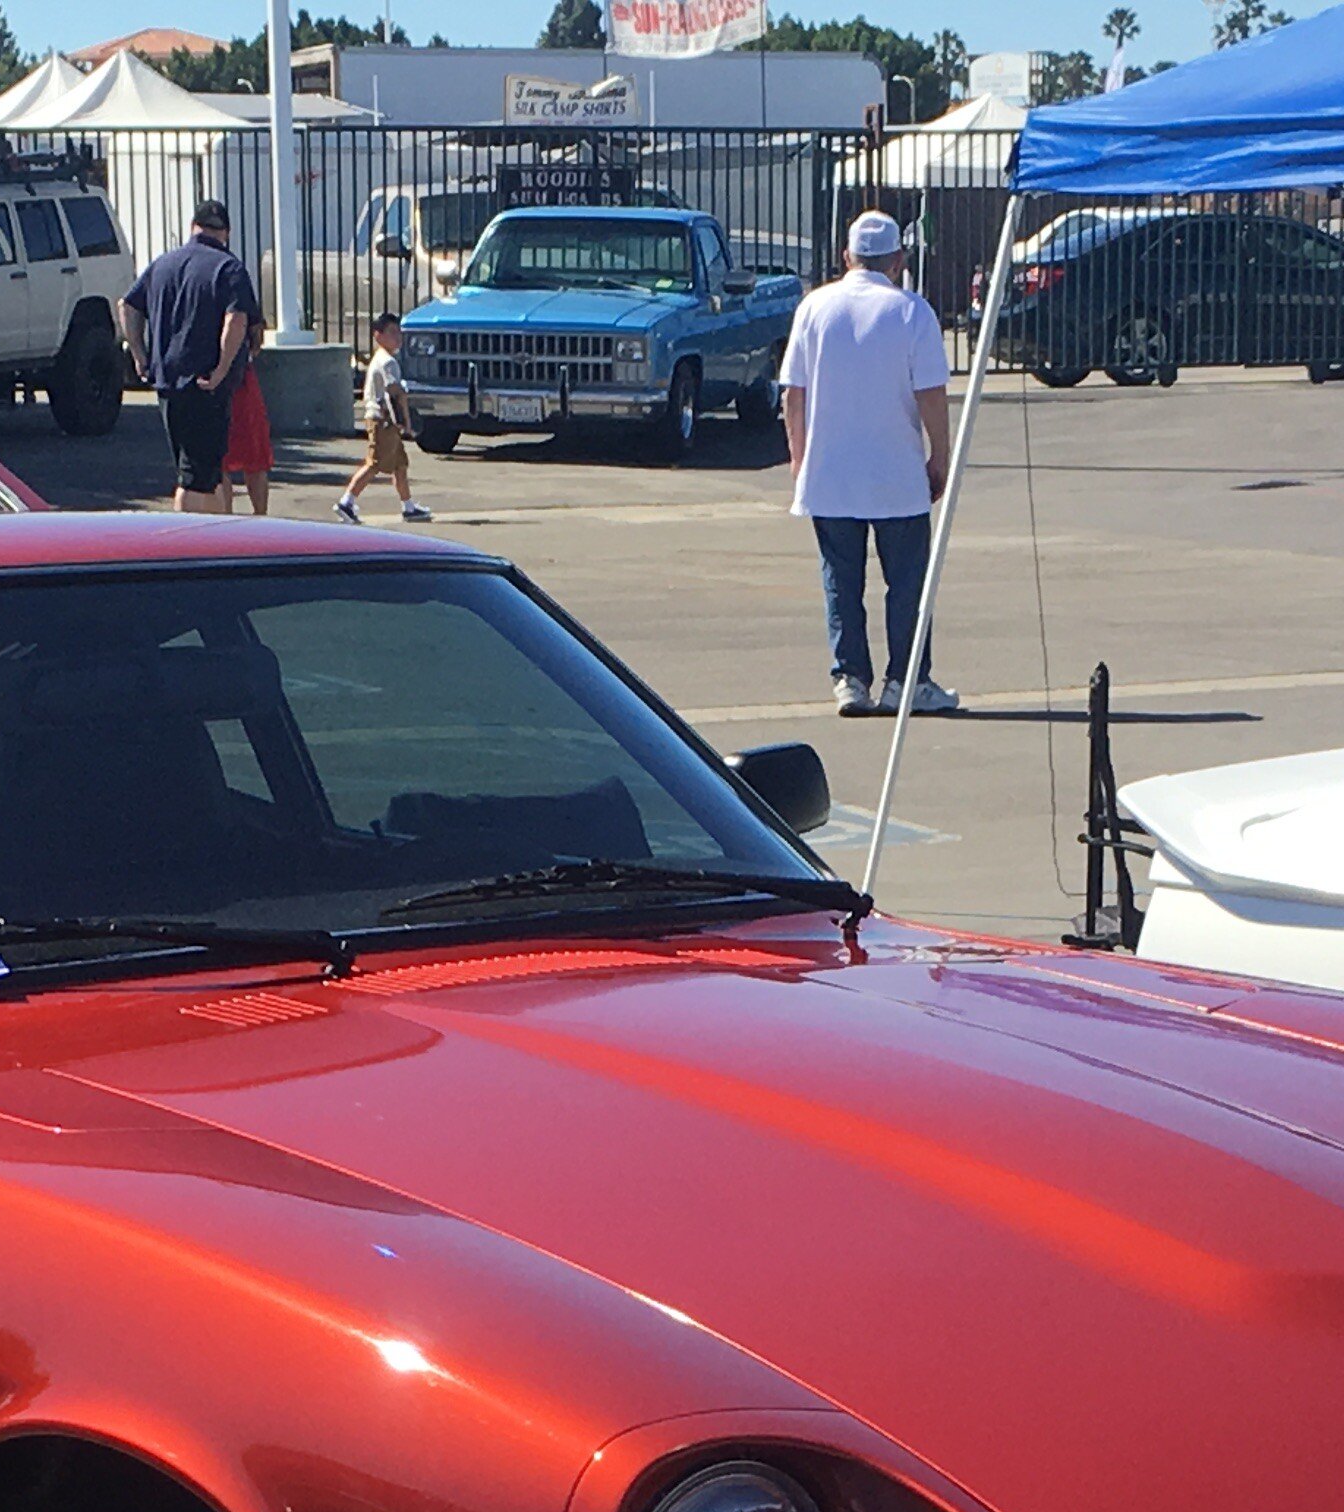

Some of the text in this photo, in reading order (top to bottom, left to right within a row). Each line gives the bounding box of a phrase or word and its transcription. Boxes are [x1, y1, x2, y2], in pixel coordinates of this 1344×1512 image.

[541, 101, 579, 116] CAMP
[582, 100, 627, 117] SHIRTS
[520, 171, 611, 188] WOODIS
